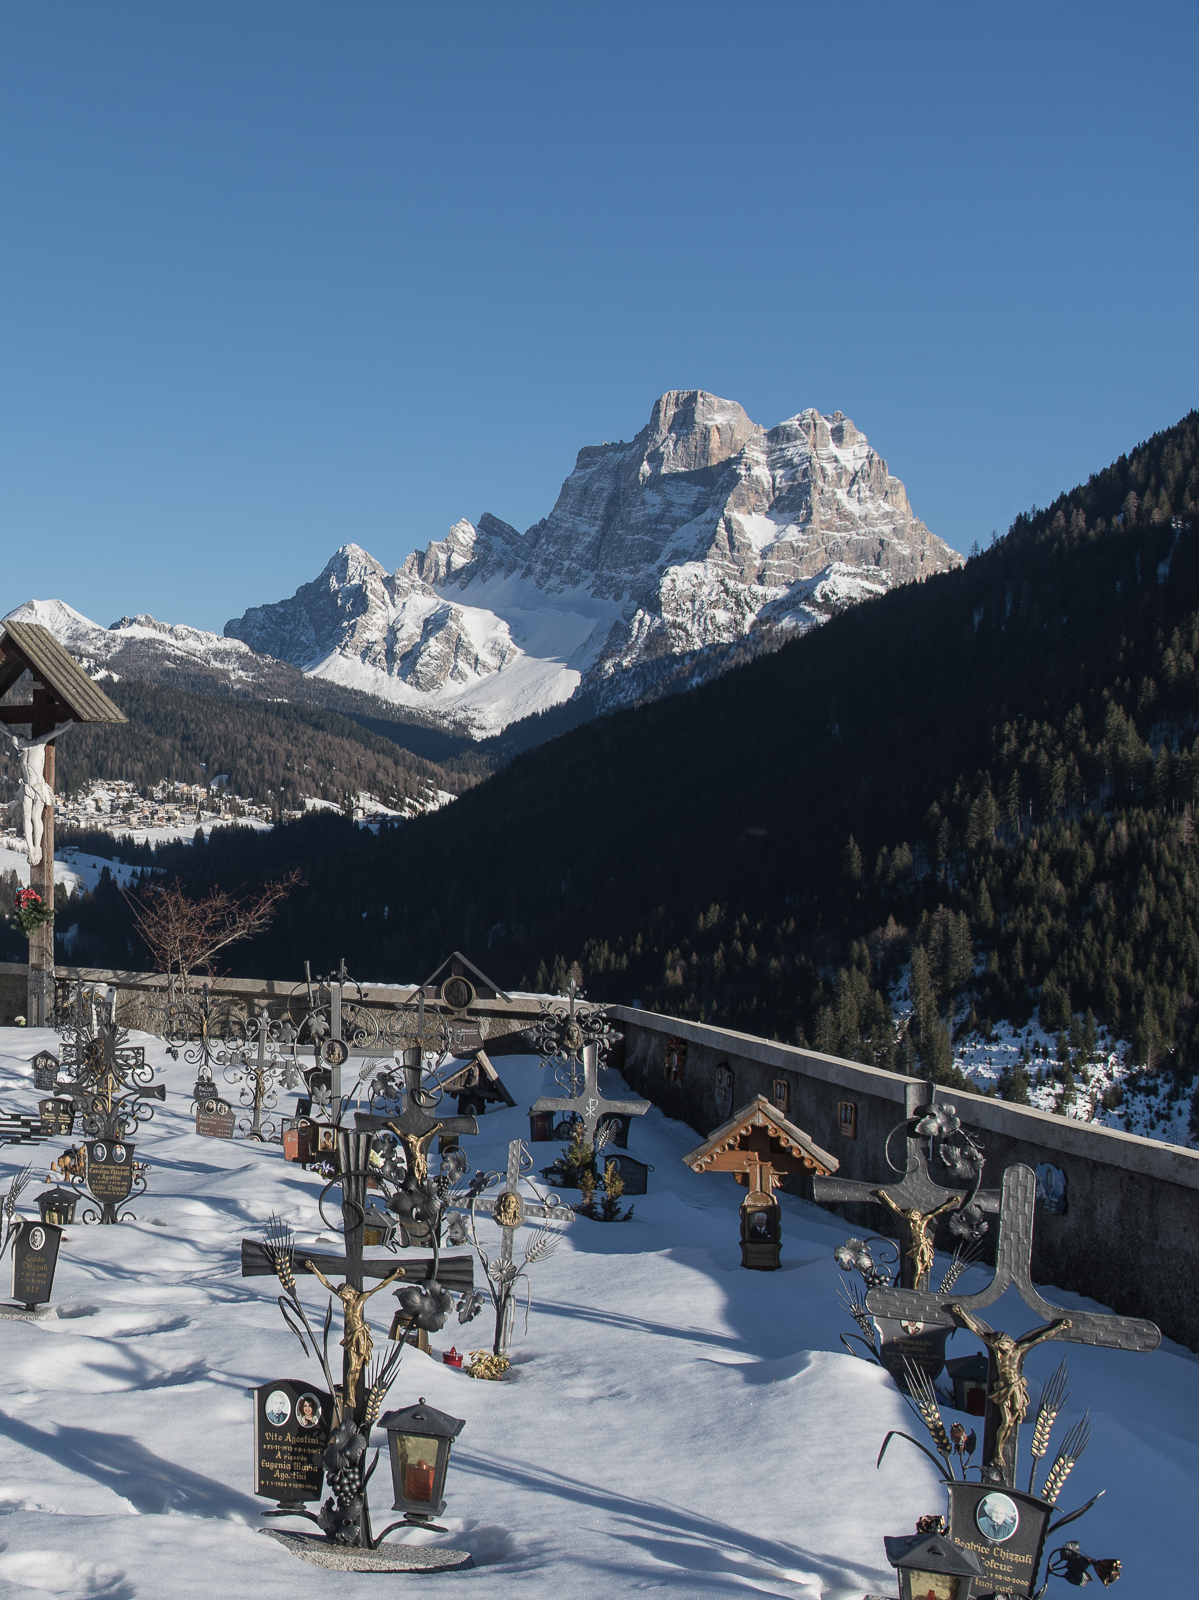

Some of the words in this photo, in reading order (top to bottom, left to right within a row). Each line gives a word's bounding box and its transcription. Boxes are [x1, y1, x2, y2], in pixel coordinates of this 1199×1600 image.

[26, 1254, 45, 1263] Guido
[22, 1261, 48, 1272] Chizzali
[893, 1337, 932, 1346] Ferdinando
[897, 1344, 927, 1353] Agostini
[264, 1432, 283, 1441] Vito
[284, 1432, 319, 1444] Agostini
[275, 1451, 282, 1459] A
[261, 1459, 292, 1470] Eugenia
[293, 1461, 319, 1472] Maria
[954, 1537, 991, 1555] Beatrice
[993, 1547, 1033, 1565] Chizzali
[982, 1556, 1014, 1572] olcuc
[975, 1577, 993, 1589] tuoi
[995, 1585, 1014, 1594] cari
